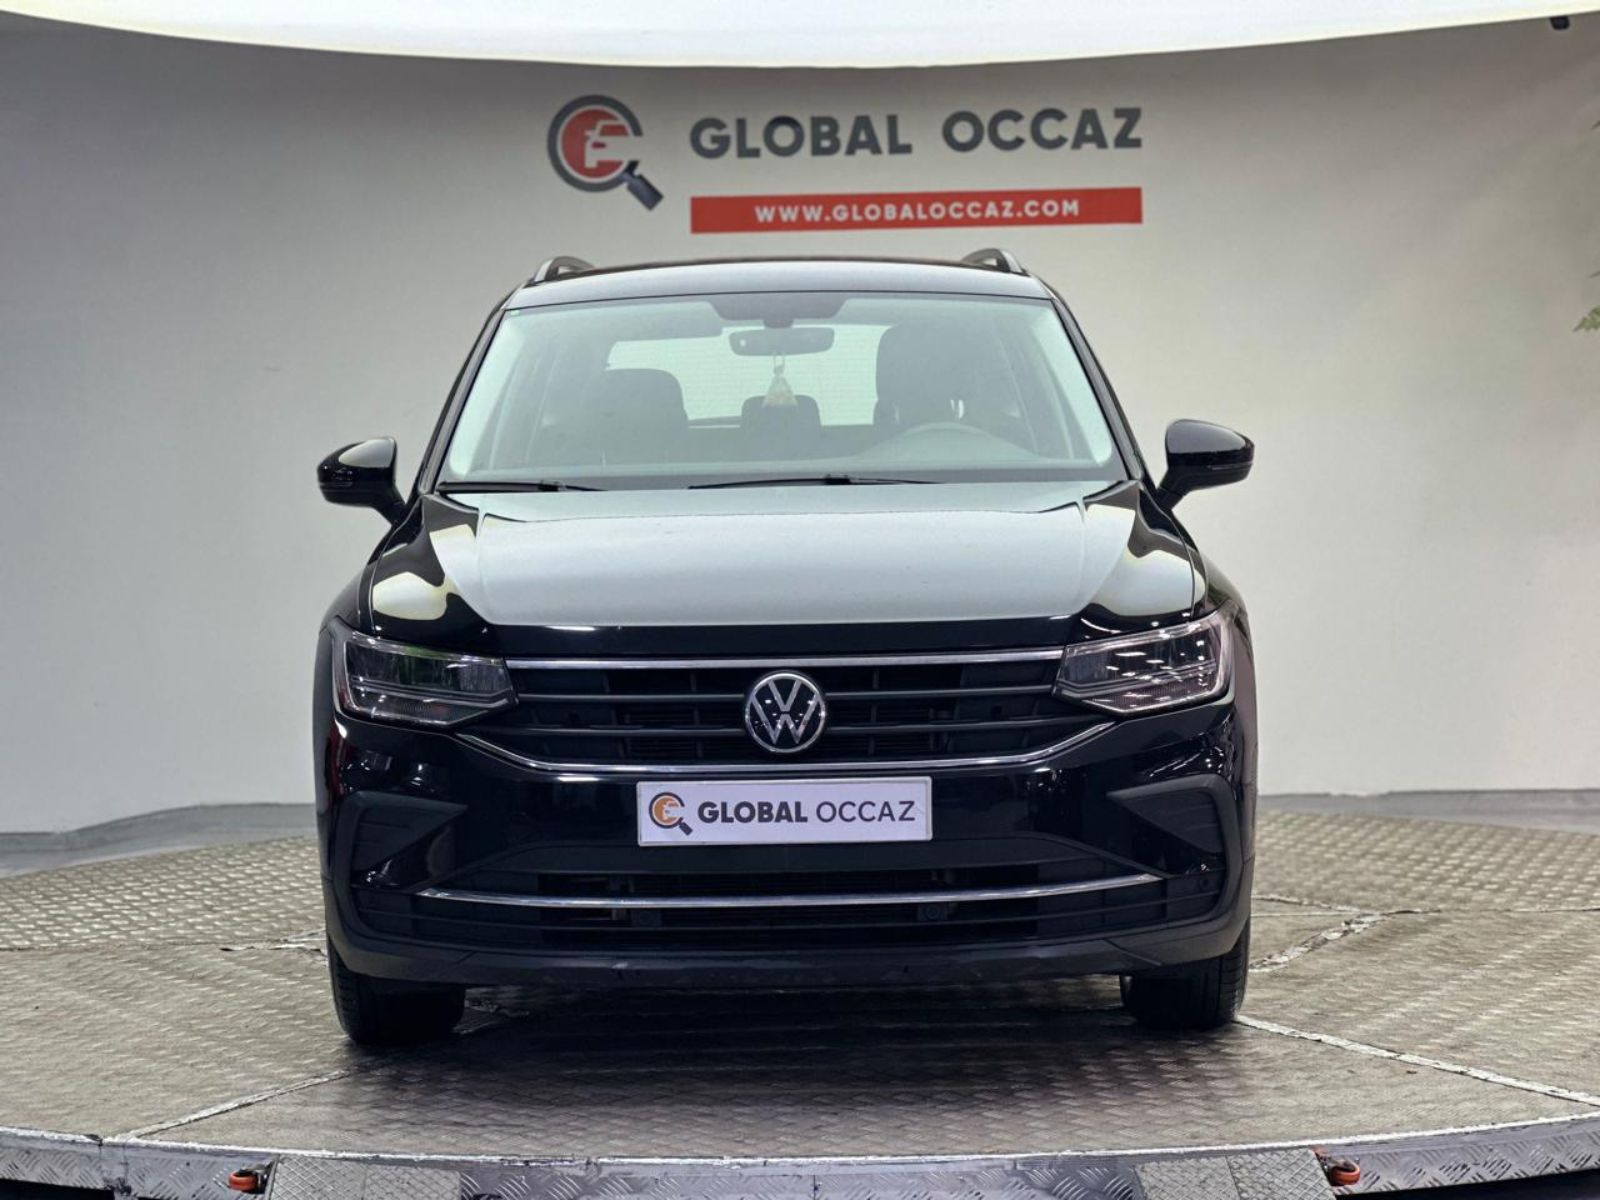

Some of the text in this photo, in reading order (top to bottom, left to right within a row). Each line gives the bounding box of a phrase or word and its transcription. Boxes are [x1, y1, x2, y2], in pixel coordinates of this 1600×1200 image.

[689, 107, 1143, 159] GLOBAL OCCAZ
[754, 199, 1080, 224] WWW.GLOBALOCCAZ.COM
[698, 800, 916, 823] GLOBAL OCCAZ
